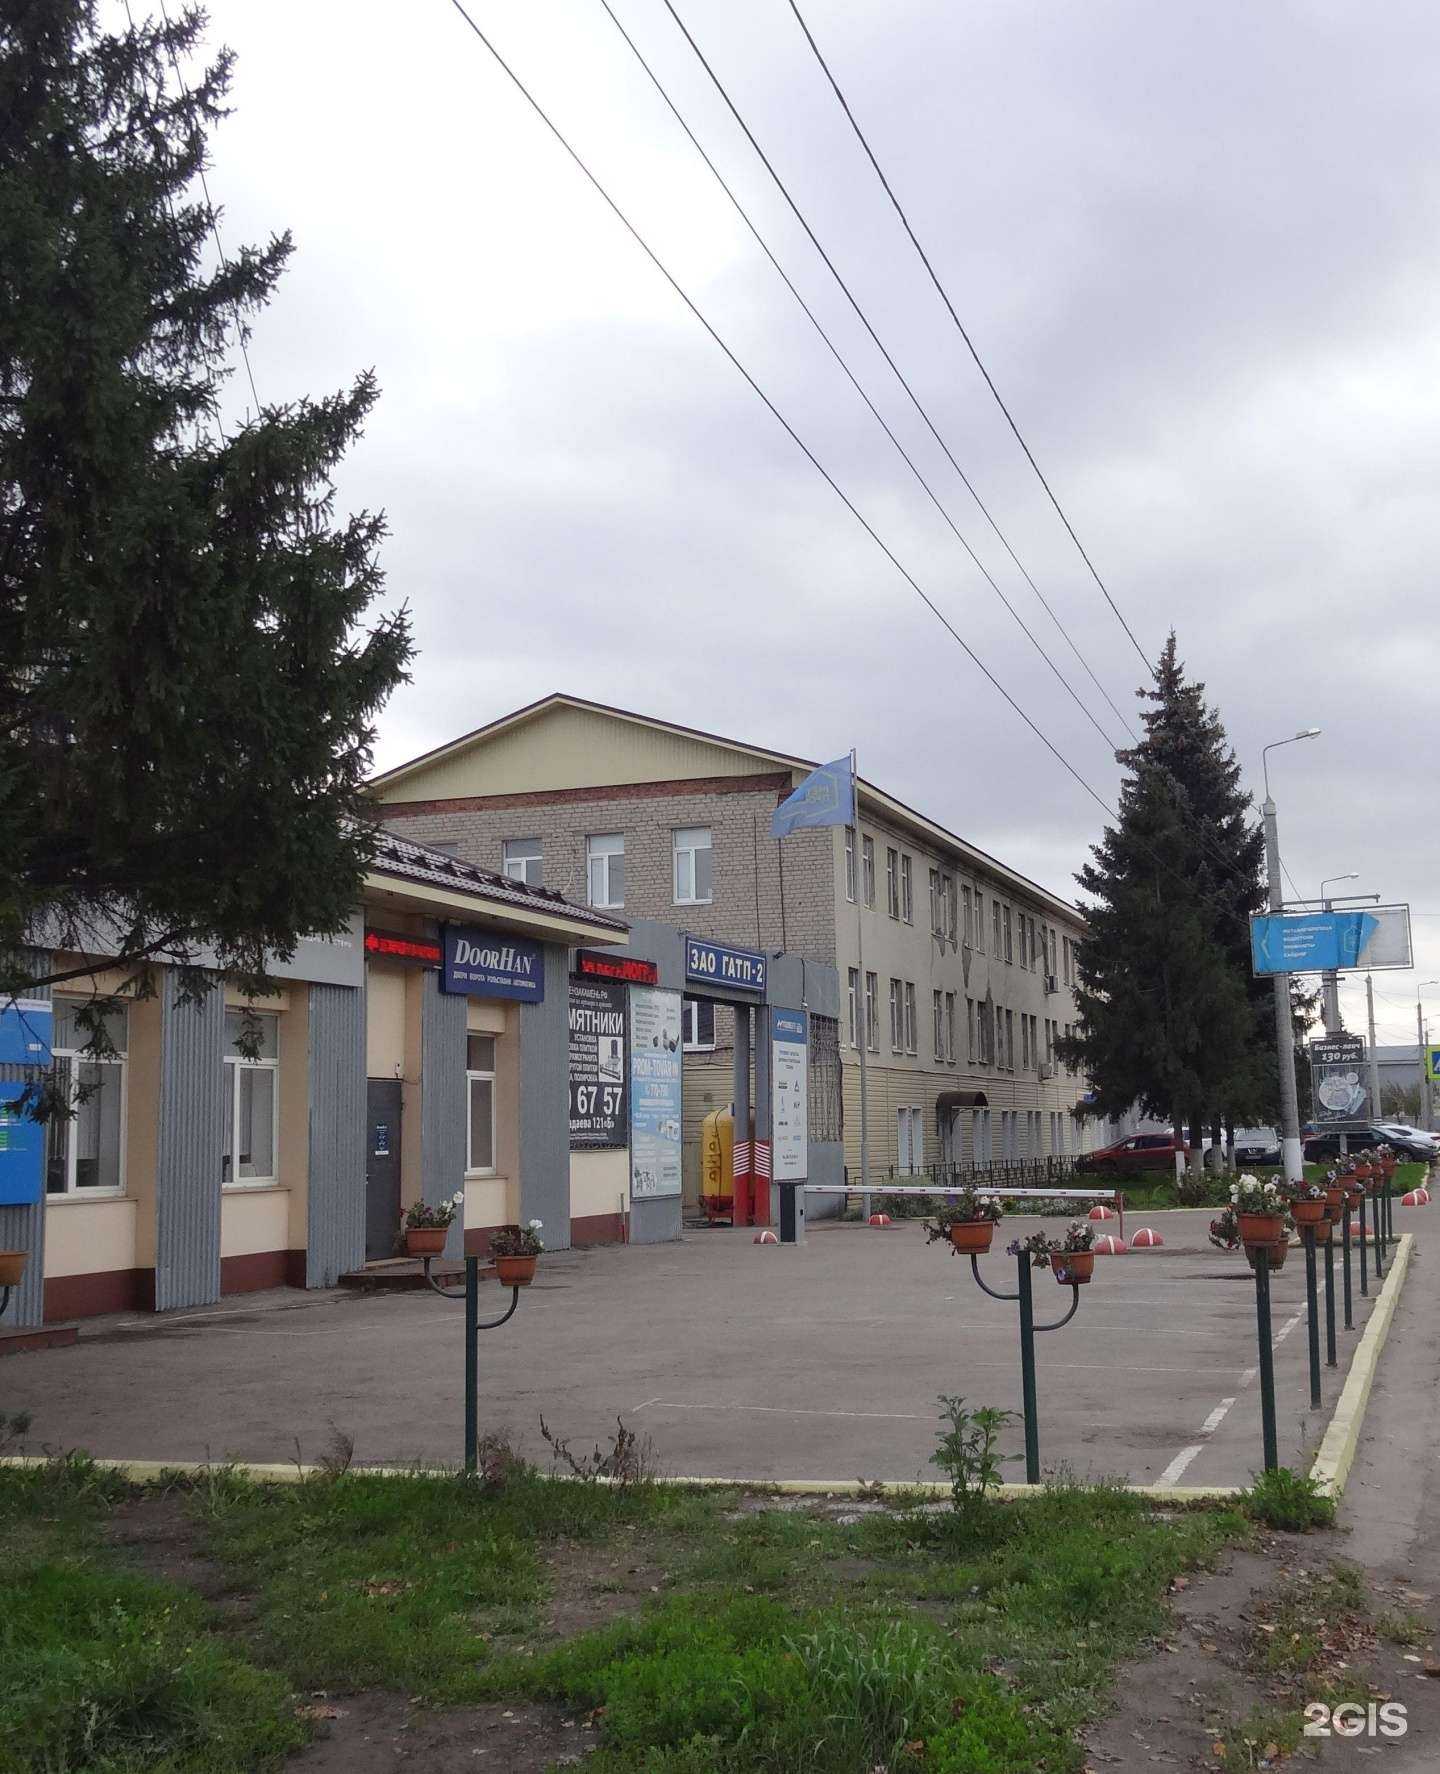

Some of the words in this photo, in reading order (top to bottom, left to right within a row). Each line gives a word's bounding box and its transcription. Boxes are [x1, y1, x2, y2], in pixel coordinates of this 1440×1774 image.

[691, 949, 716, 973] ЗАО
[722, 956, 763, 983] ГАТП-2
[1321, 1052, 1341, 1063] 130
[577, 1086, 597, 1114] 67
[603, 1087, 623, 1115] 57
